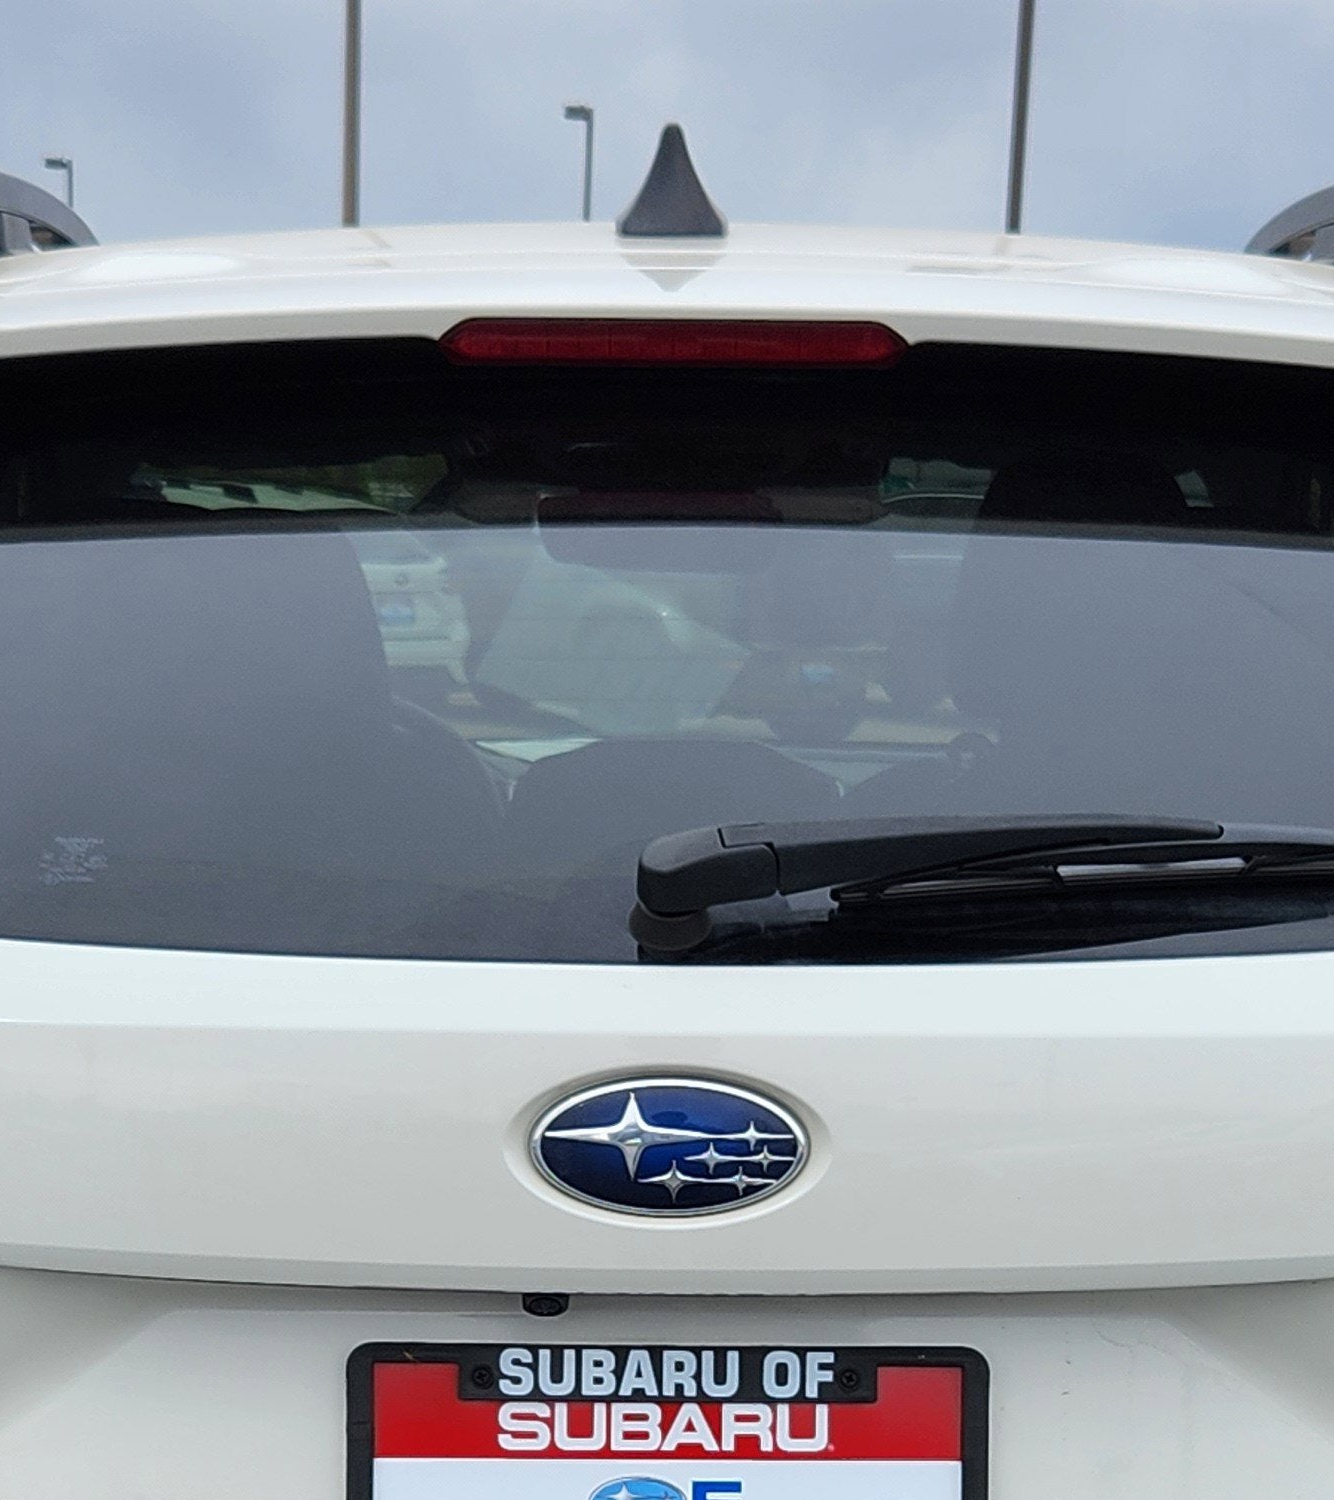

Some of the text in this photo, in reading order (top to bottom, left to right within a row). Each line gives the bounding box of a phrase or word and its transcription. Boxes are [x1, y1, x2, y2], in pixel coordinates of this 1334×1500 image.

[498, 1348, 835, 1399] SUBARU OF
[497, 1401, 829, 1452] SUBARU
